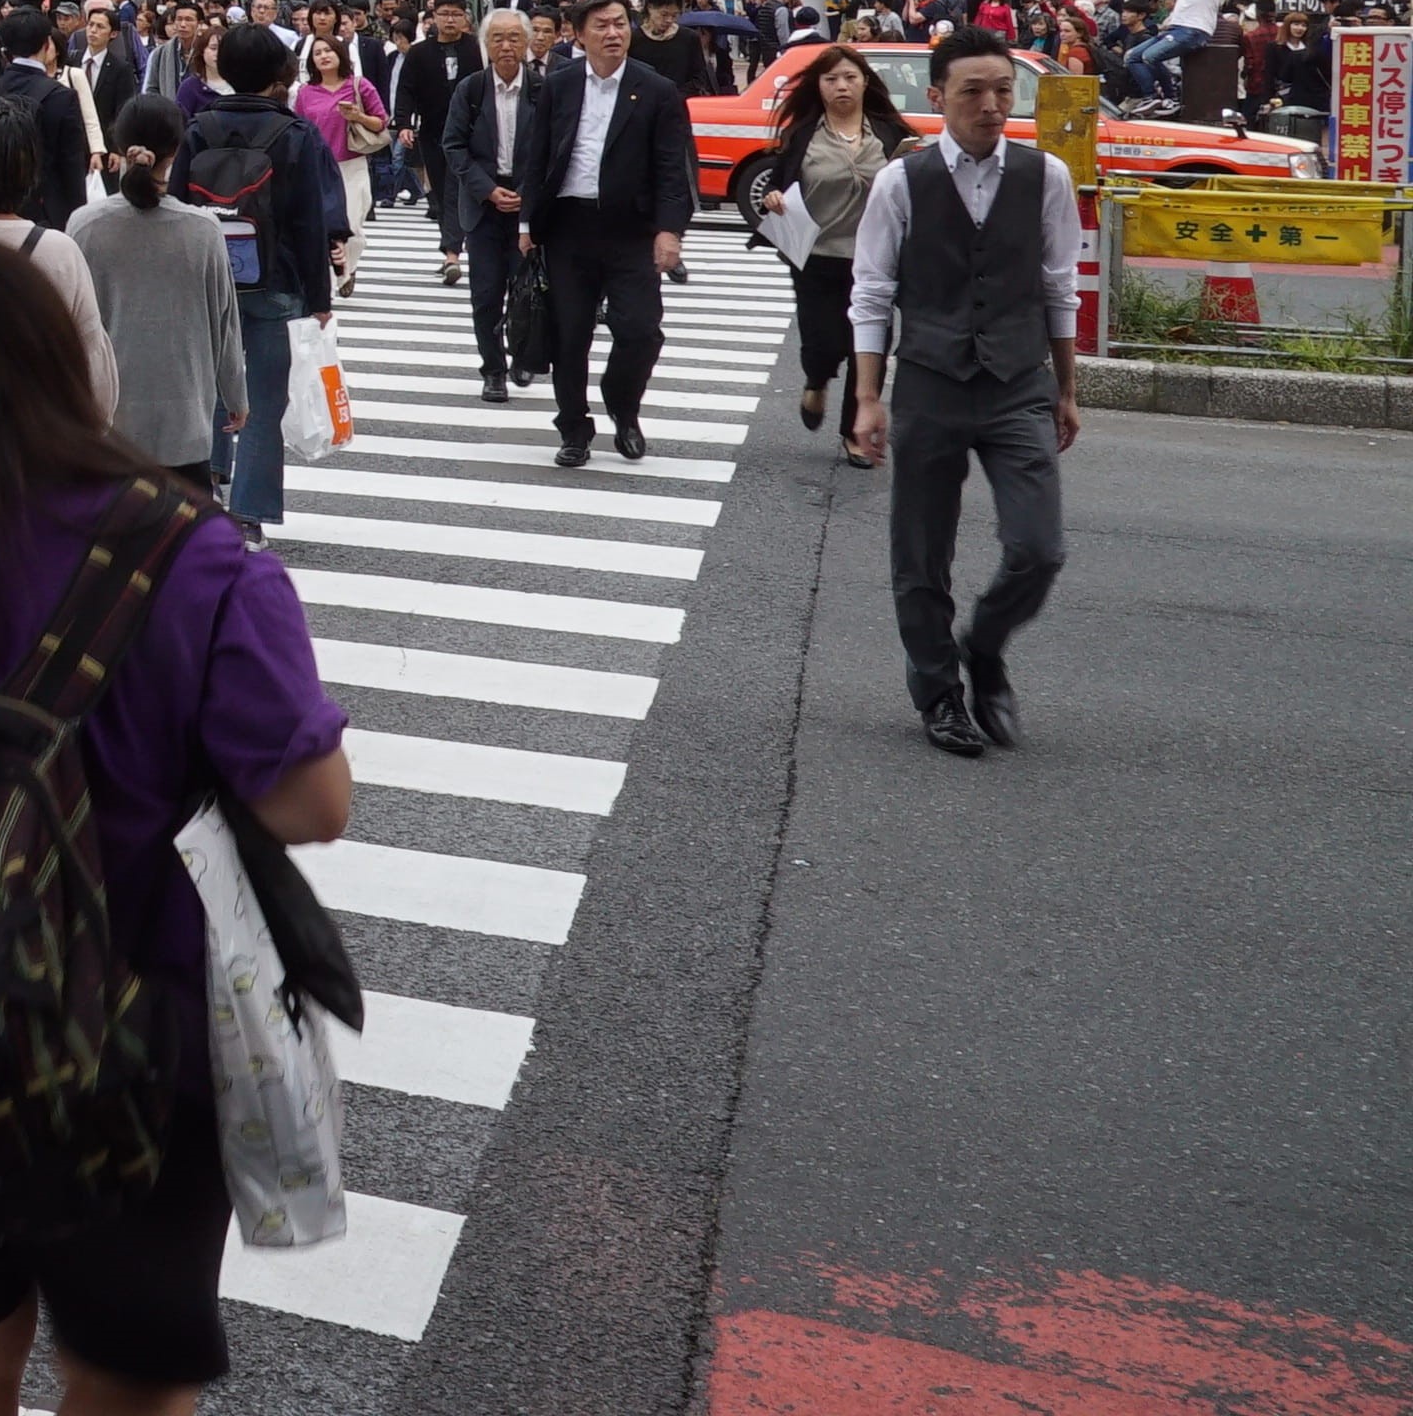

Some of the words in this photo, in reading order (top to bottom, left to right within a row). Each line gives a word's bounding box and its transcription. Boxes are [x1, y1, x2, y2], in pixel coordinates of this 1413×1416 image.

[1340, 42, 1372, 181] 駐停車禁止
[1376, 42, 1408, 182] バス停につき
[1175, 221, 1233, 243] 安全
[1279, 226, 1339, 246] 第一
